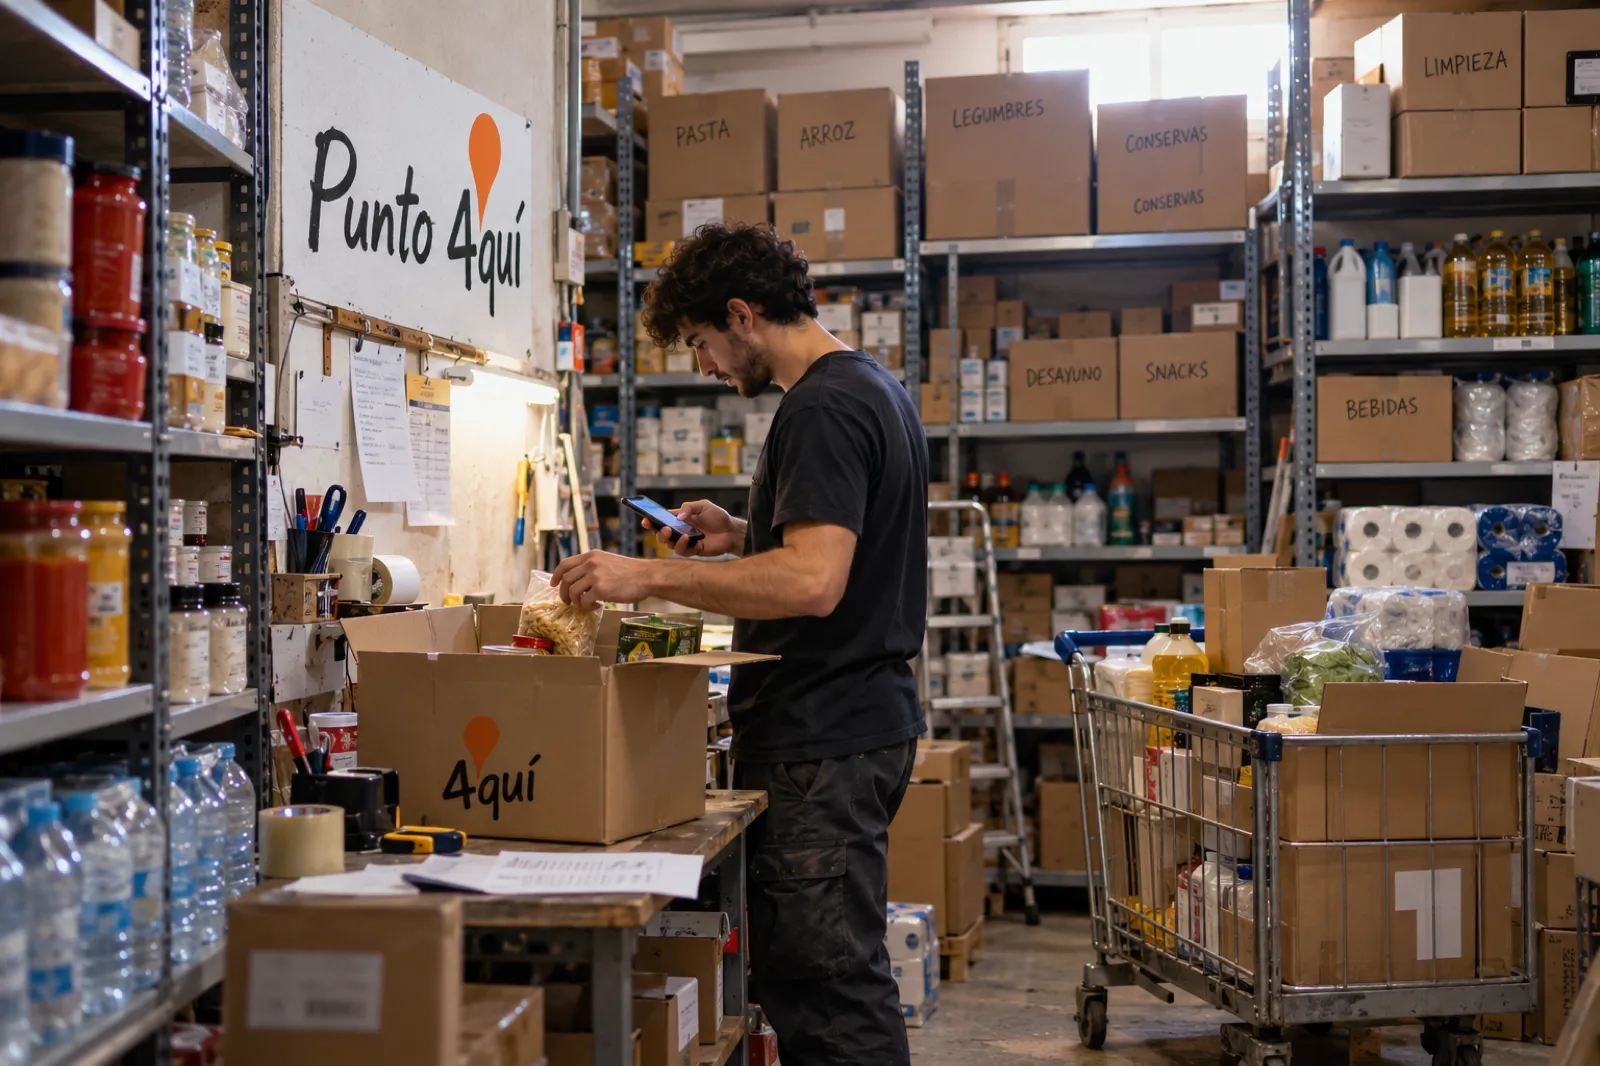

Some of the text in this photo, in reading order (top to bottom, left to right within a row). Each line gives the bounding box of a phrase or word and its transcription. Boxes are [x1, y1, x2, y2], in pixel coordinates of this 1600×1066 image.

[1424, 49, 1508, 78] LIMPIEZA
[953, 99, 1045, 129] LEGUMBRES
[676, 119, 731, 149] PASTA
[800, 120, 856, 150] ARROZ
[1125, 125, 1208, 153] CONSERVAS
[308, 125, 434, 265] Punto
[1134, 189, 1205, 215] CONSERVAS
[1026, 365, 1102, 388] DESAYUNO
[1145, 361, 1209, 384] SNACKS
[1346, 396, 1418, 421] BEBIDAS
